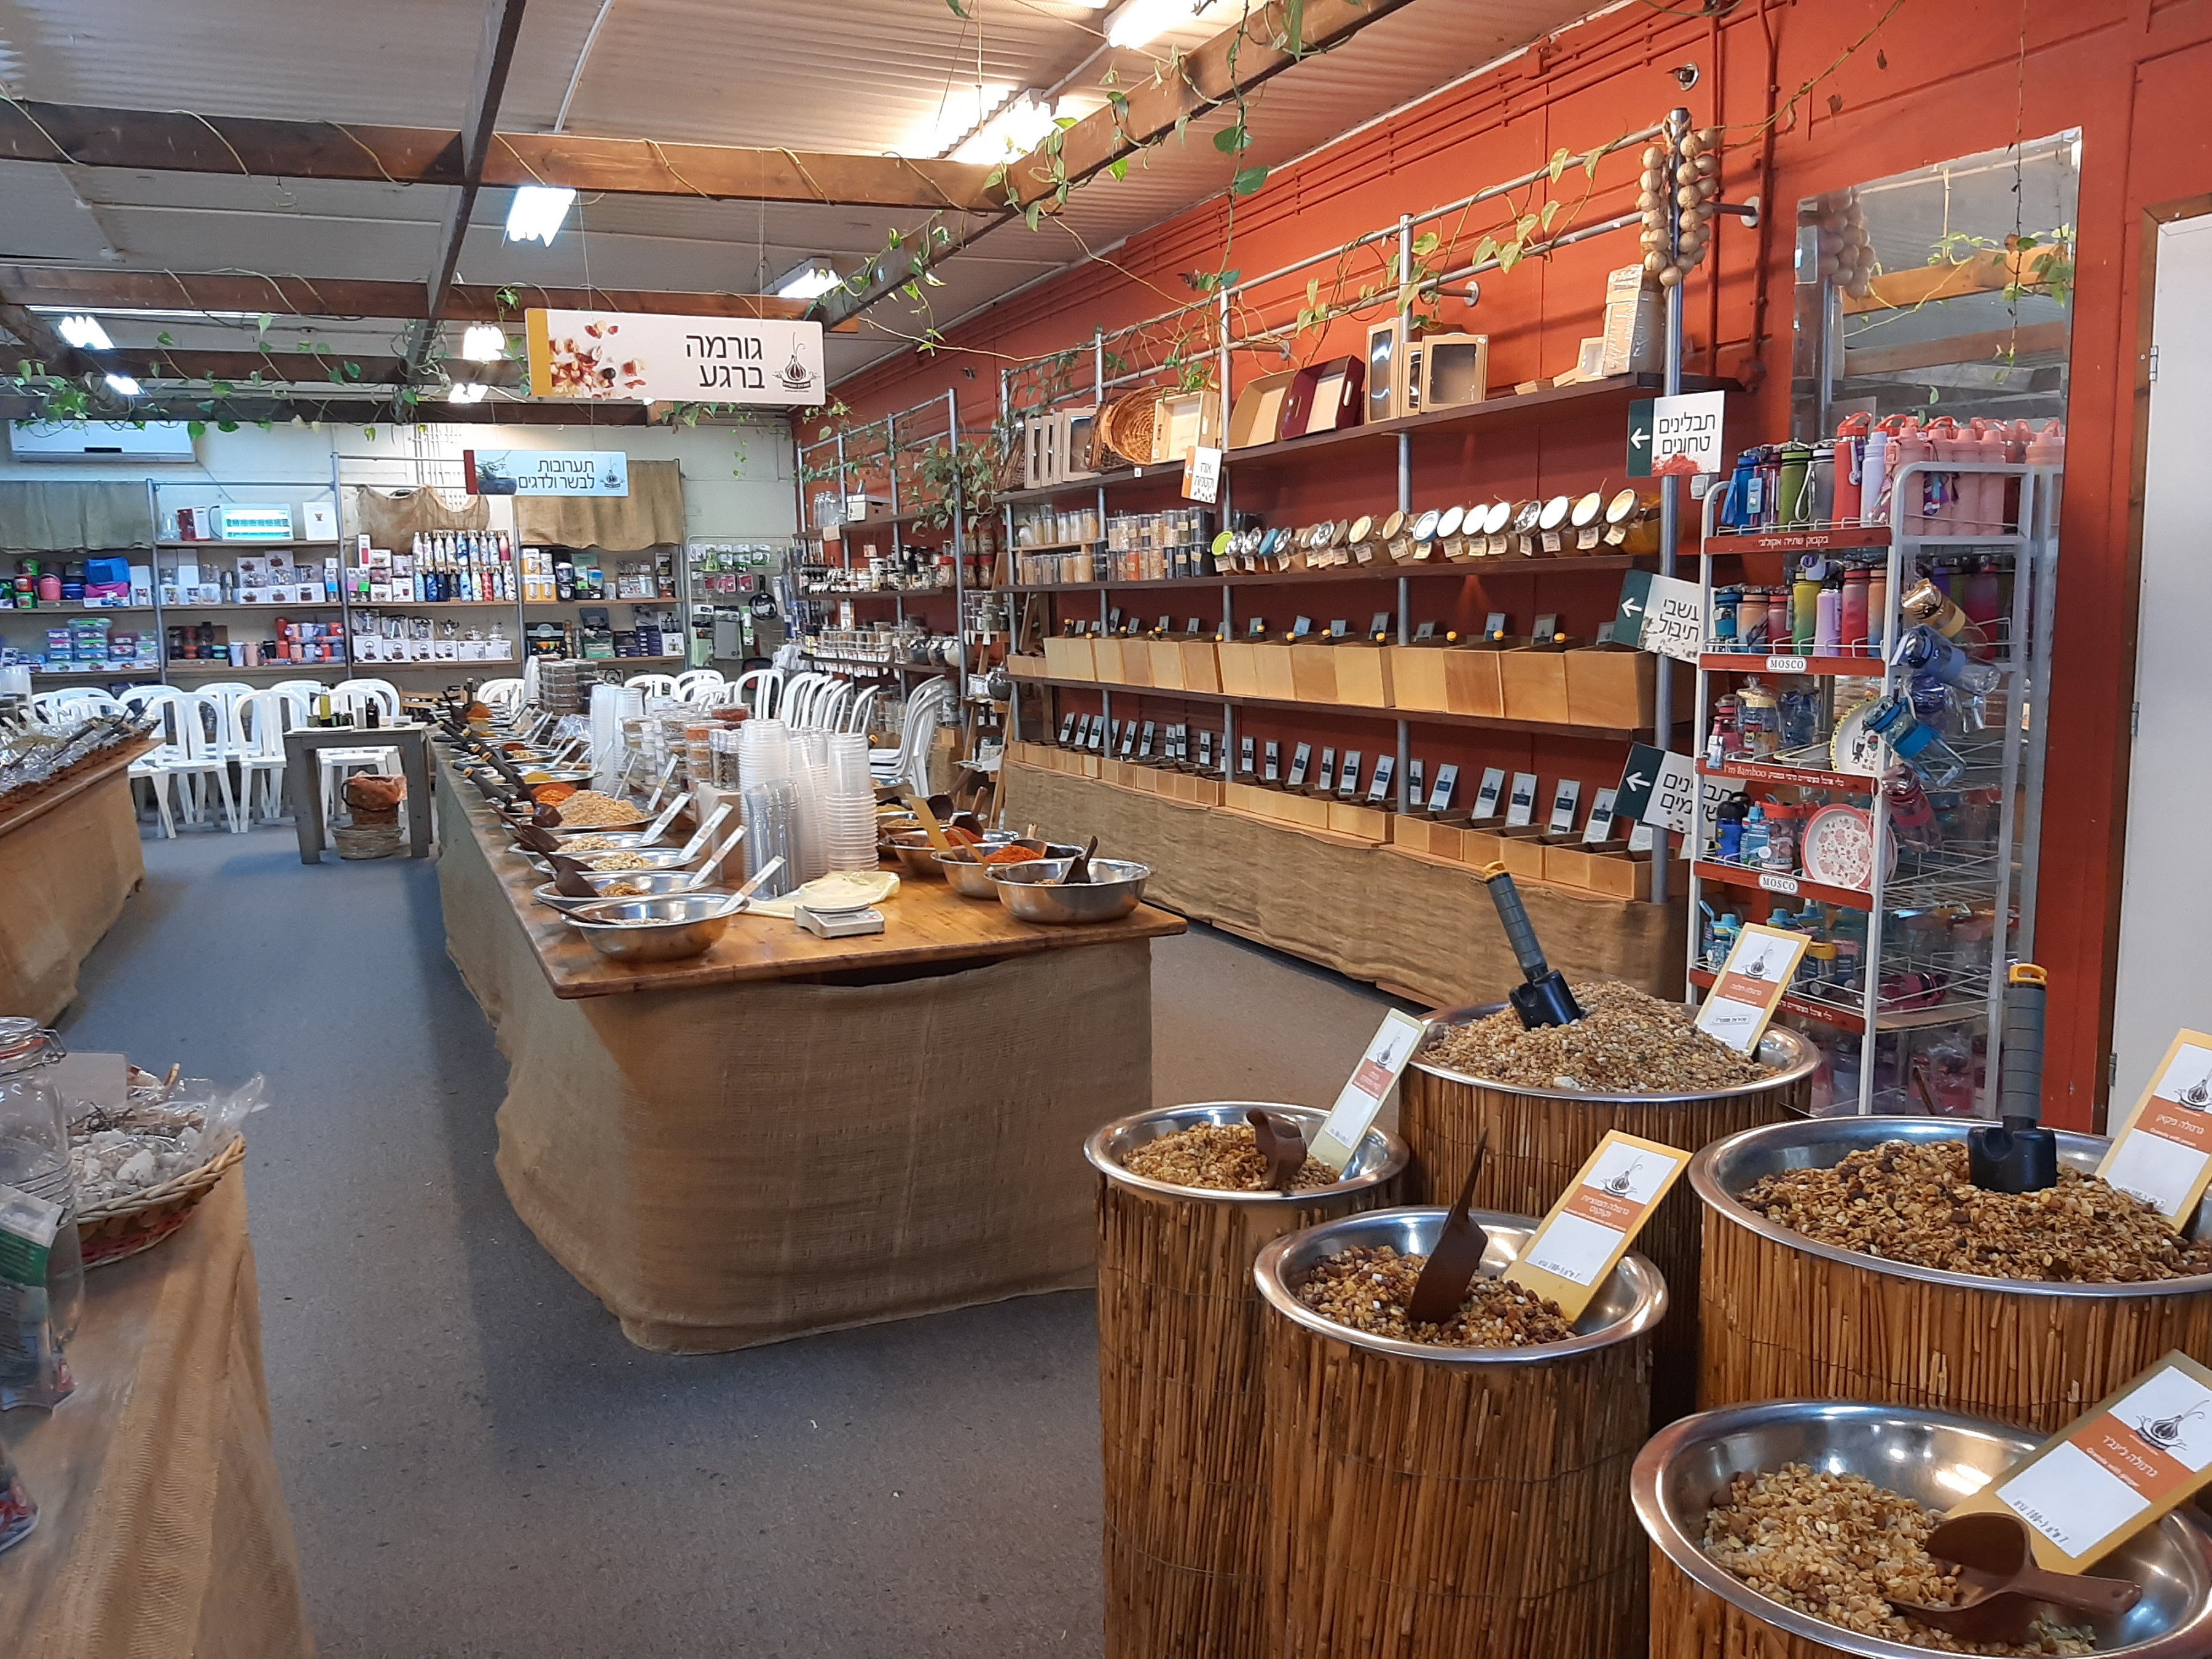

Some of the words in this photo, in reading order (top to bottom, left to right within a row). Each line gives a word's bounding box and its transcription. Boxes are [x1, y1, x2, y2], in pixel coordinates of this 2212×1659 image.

[686, 335, 763, 360] גורמה
[699, 364, 766, 389] ברגע
[1659, 411, 1716, 434] תבלינים
[1662, 436, 1711, 455] טחונים
[537, 460, 595, 473] תערובות
[519, 473, 557, 489] ולדגים
[560, 473, 595, 489] לבשר
[1658, 613, 1699, 643] תיבול
[1770, 659, 1804, 669] MOSCO
[1736, 763, 1767, 778] Bamboo
[1663, 773, 1732, 802] תבנים
[1660, 793, 1718, 822] שמים
[1763, 877, 1795, 890] MOSCO
[2126, 1454, 2158, 1478] גרנולה
